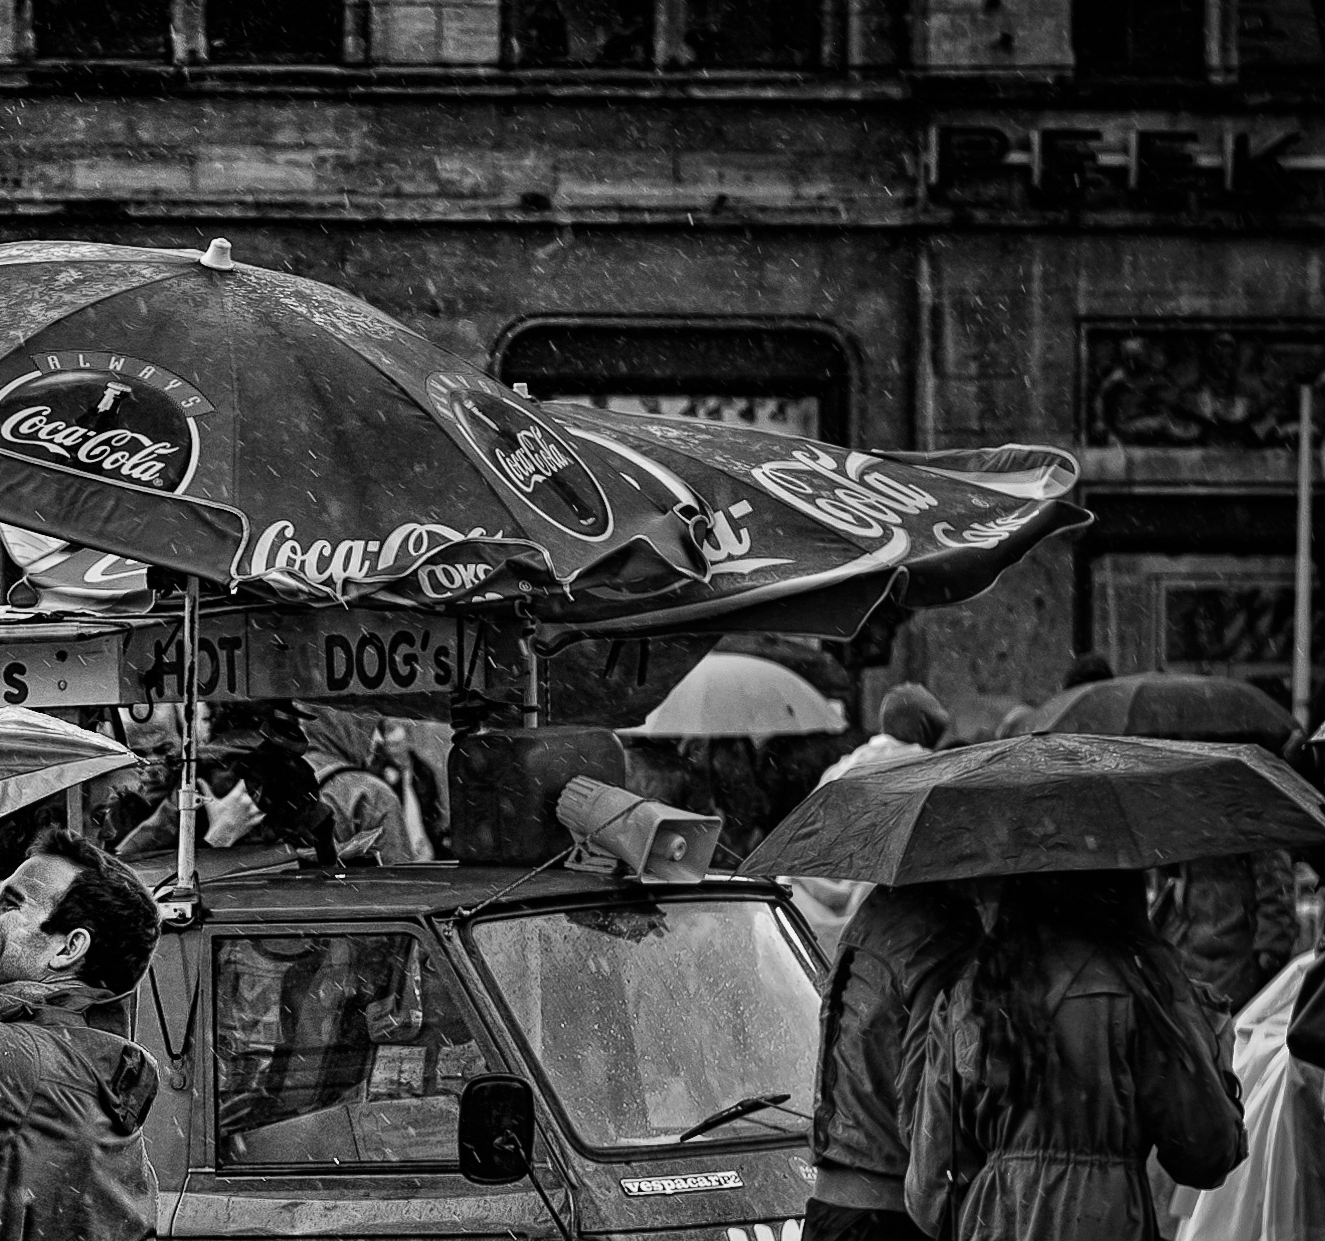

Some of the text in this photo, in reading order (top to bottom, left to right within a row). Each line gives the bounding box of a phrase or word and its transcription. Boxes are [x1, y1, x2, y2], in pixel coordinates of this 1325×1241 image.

[47, 353, 202, 409] ALWAYS
[0, 405, 180, 482] Coca-Cola
[326, 630, 452, 691] DOG's
